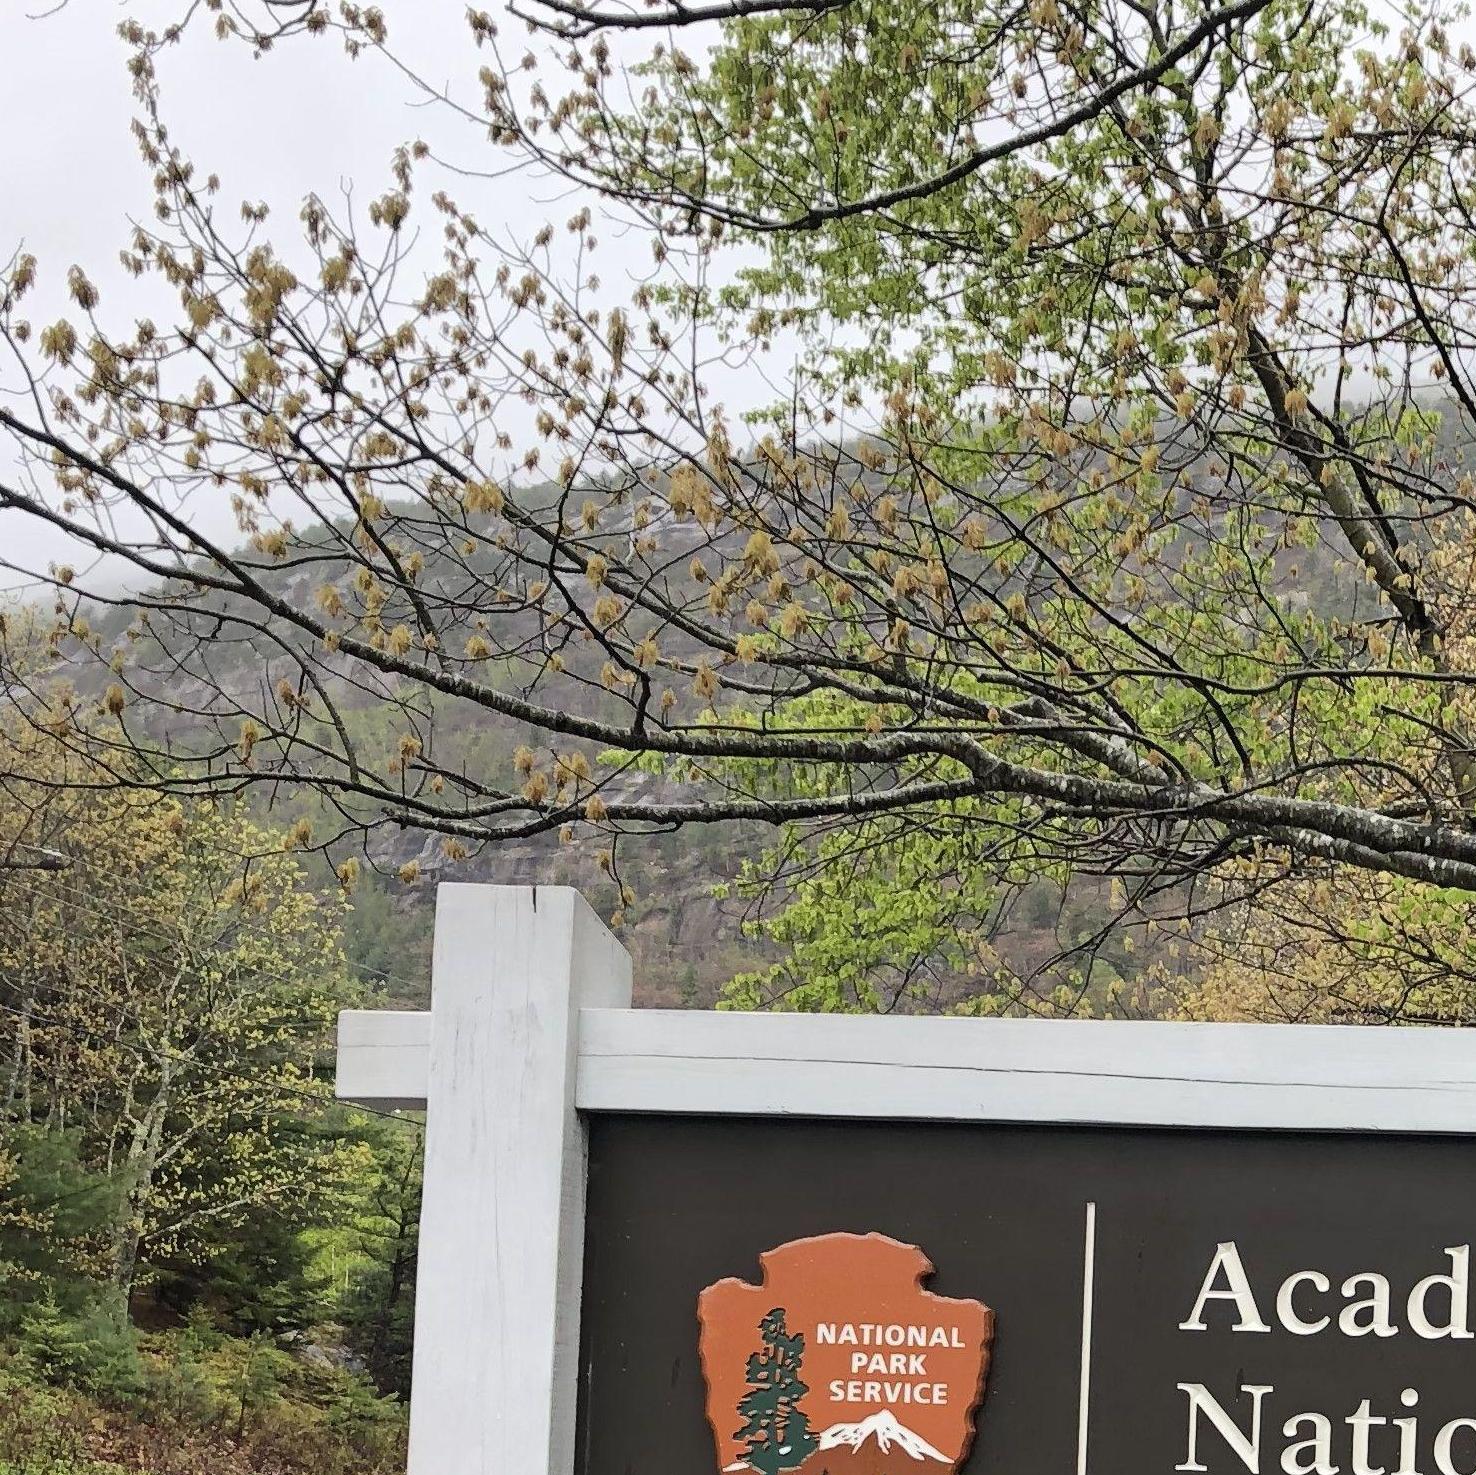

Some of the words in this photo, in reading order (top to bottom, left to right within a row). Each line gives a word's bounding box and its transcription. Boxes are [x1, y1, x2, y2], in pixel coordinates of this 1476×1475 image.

[816, 1322, 966, 1348] NATIONAL
[851, 1351, 927, 1376] PARK
[829, 1379, 948, 1405] SERVICE
